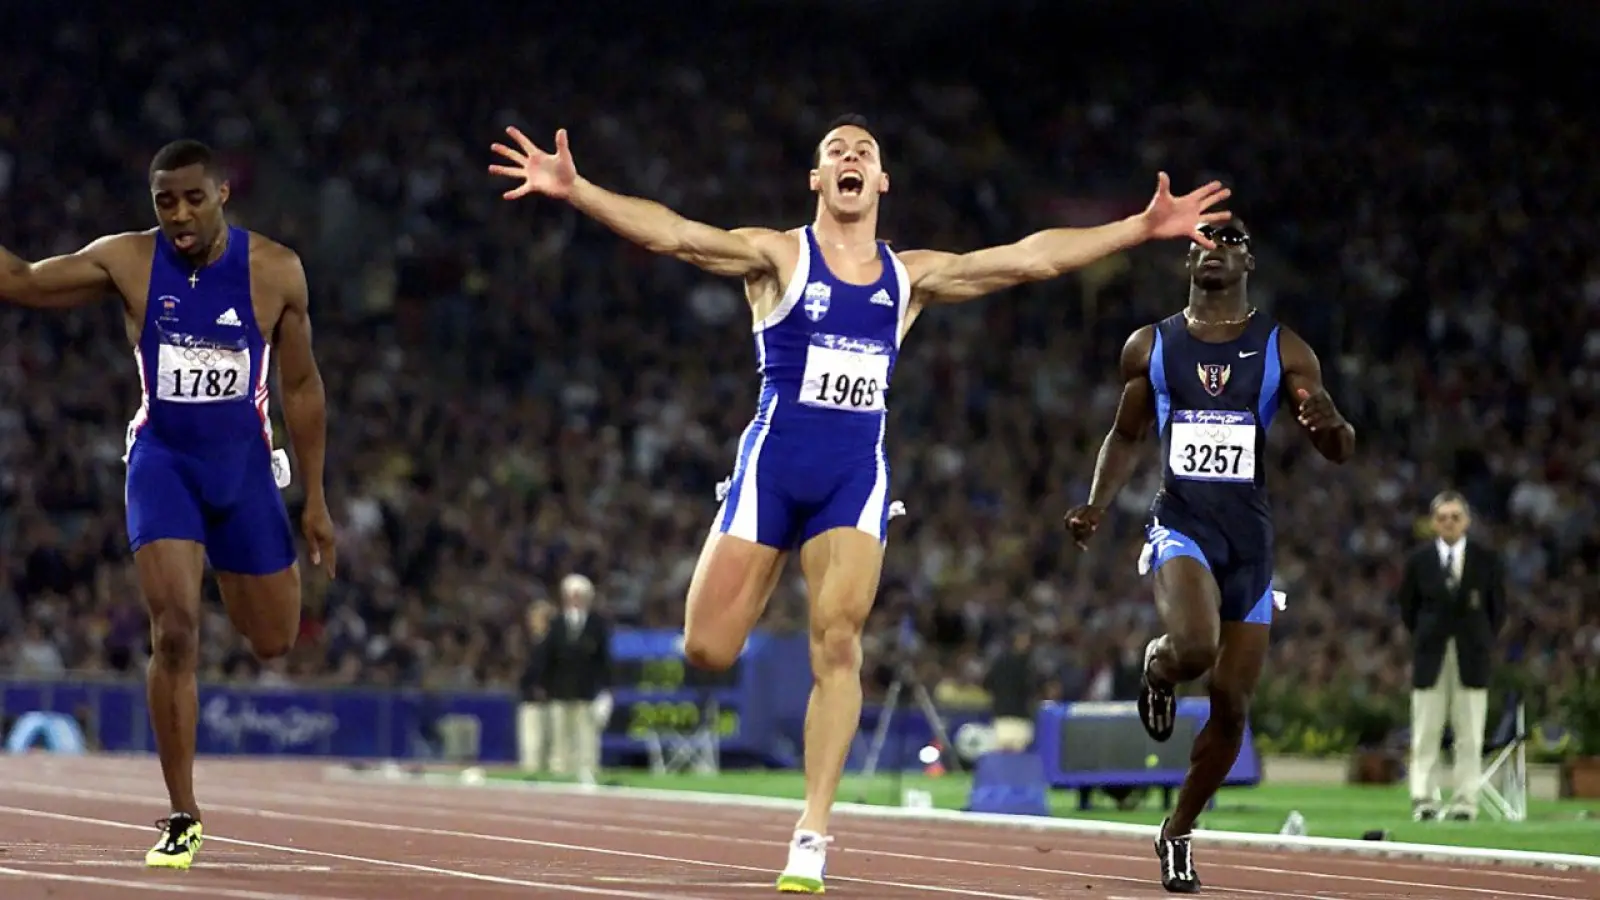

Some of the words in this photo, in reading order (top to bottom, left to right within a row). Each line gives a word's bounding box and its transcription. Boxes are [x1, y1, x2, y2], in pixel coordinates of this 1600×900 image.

[171, 368, 238, 397] 1782
[815, 372, 878, 407] 1969
[1209, 367, 1219, 389] USA
[1183, 443, 1244, 475] 3257
